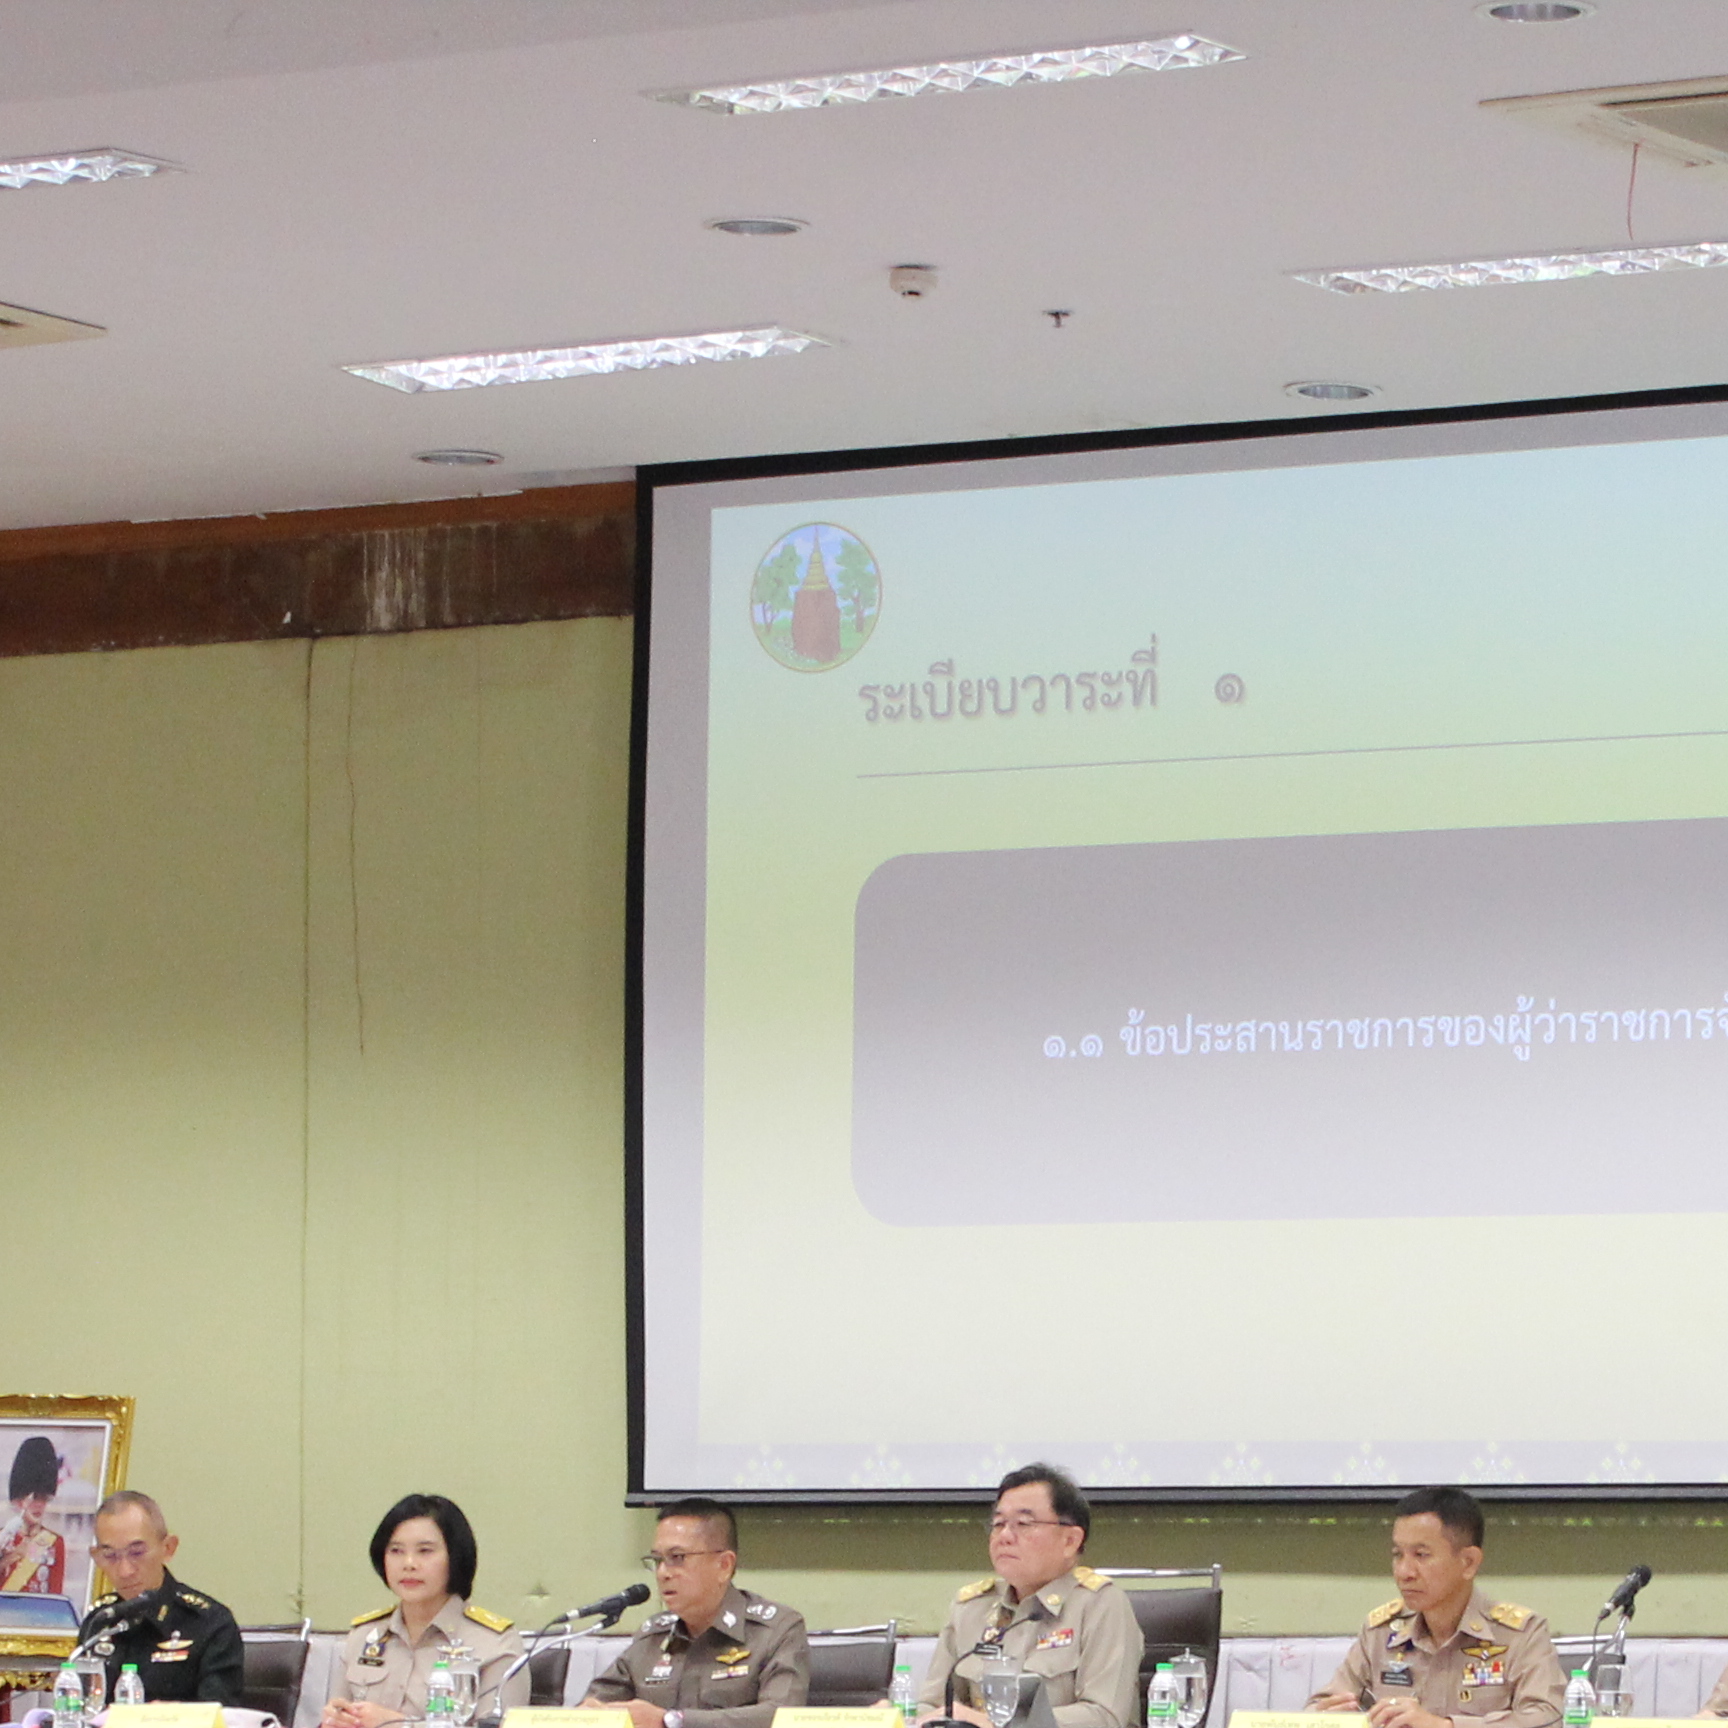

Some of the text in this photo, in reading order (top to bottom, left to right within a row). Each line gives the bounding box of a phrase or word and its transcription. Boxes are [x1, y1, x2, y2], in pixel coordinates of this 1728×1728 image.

[858, 632, 1246, 723] ระเบียบวาระที่ ๑
[1042, 1029, 1105, 1058] ๑.๑
